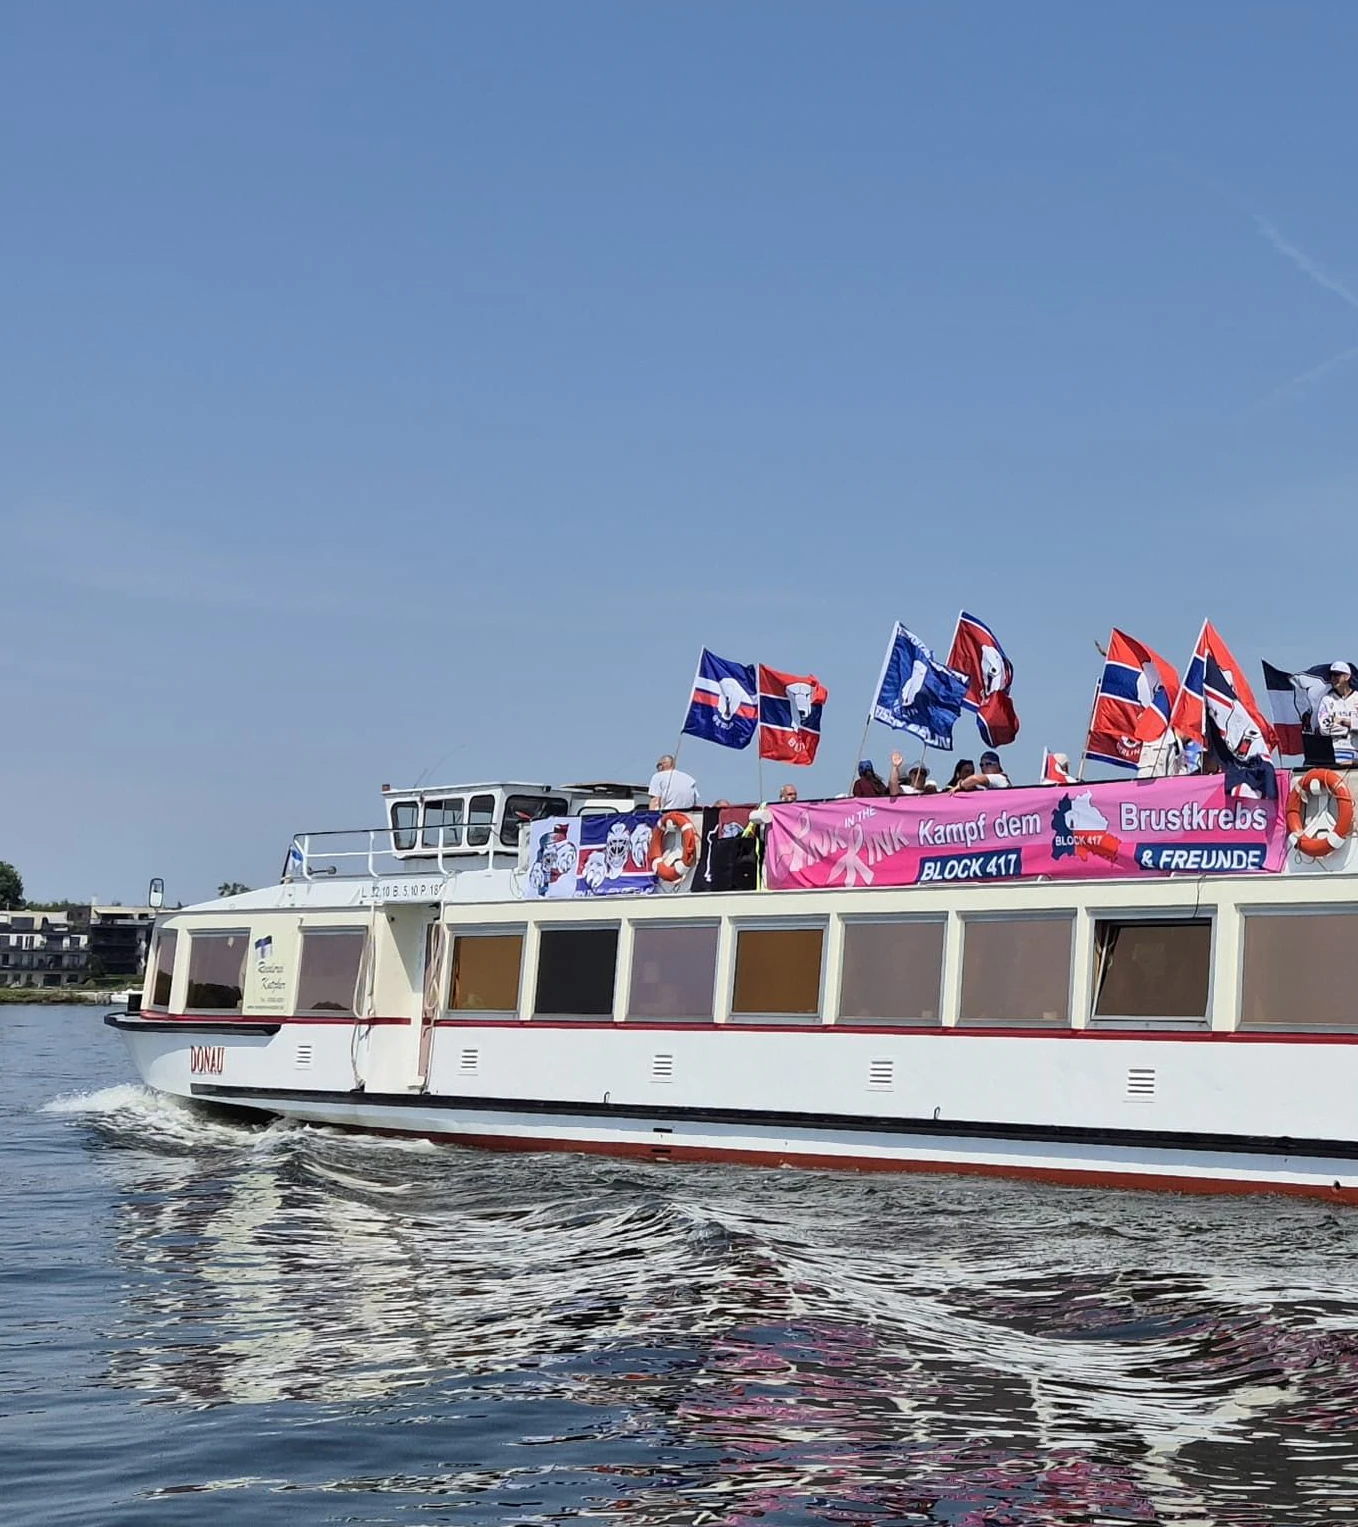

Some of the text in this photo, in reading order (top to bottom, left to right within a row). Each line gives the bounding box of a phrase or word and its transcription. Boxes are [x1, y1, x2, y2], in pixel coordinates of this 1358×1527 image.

[844, 807, 877, 828] IN THE
[918, 812, 1042, 847] Kampf dem
[1120, 802, 1268, 831] Brustkrebs
[1055, 835, 1102, 846] BLOCK 417
[921, 853, 1017, 881] BLOCK 417
[1140, 850, 1262, 869] & FREUNDE
[190, 1045, 225, 1075] DONAU
